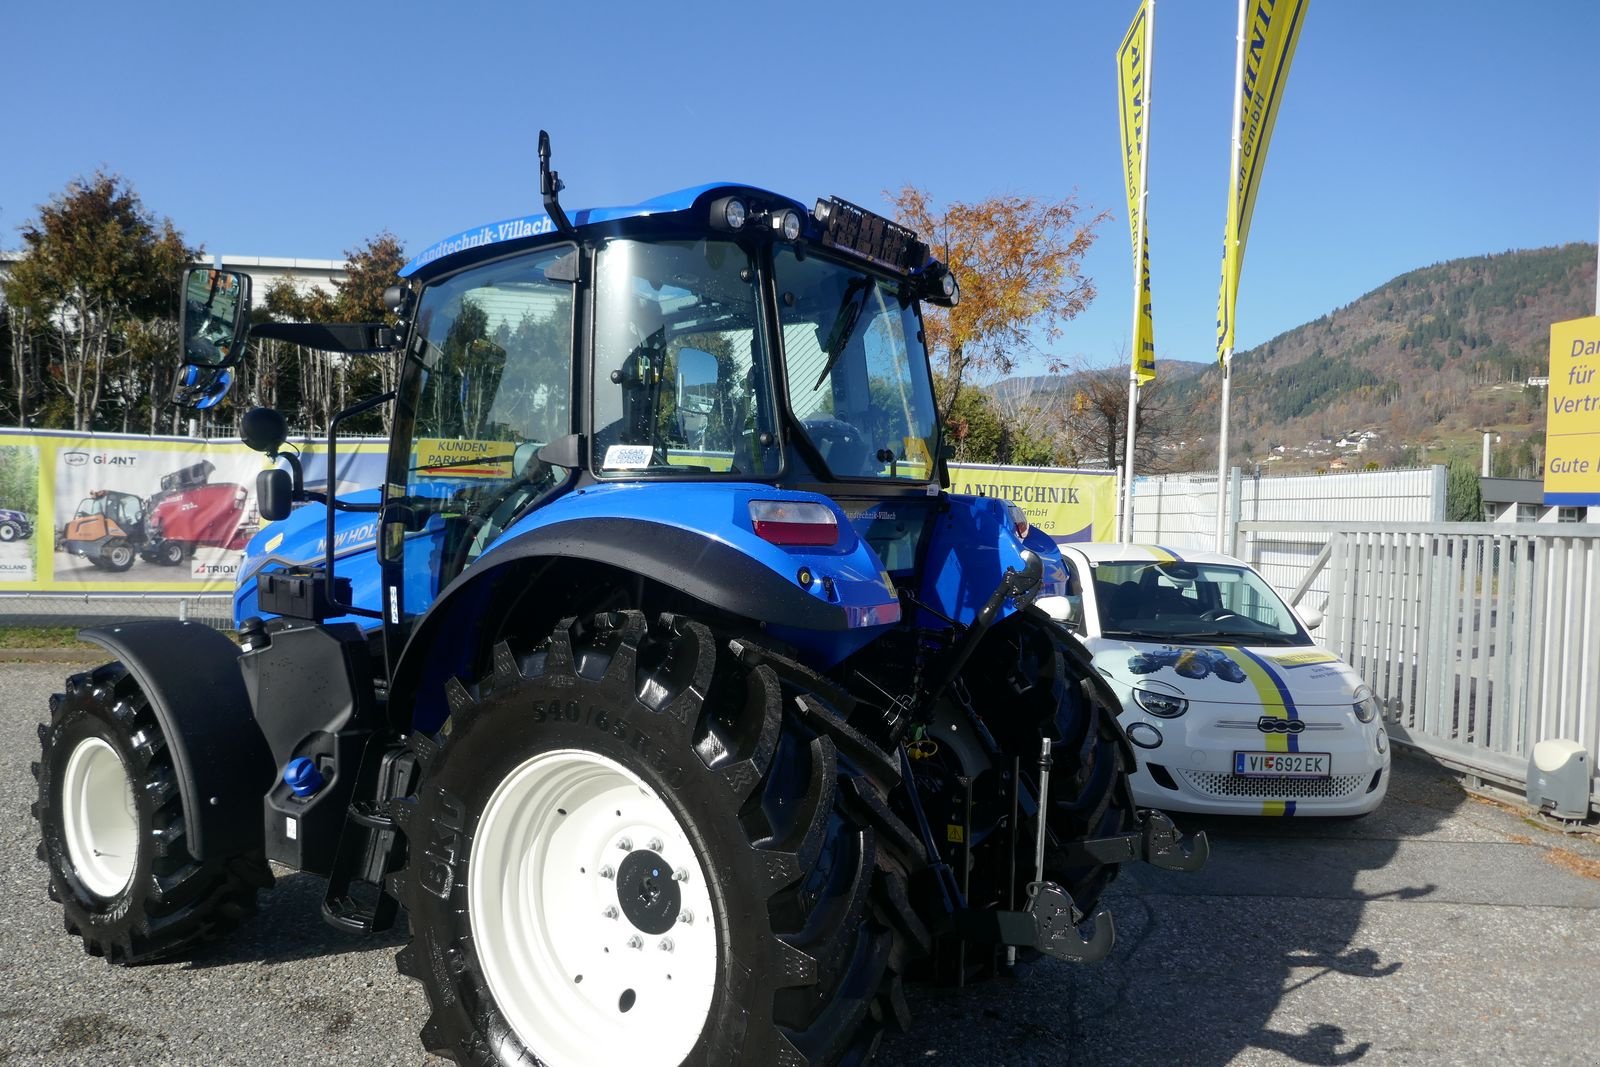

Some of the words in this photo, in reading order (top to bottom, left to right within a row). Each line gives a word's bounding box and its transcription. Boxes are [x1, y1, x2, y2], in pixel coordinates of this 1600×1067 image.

[415, 216, 552, 266] Landtechnik-Villach
[1568, 365, 1596, 385] für
[1553, 394, 1600, 414] Vertr
[438, 442, 494, 452] KUNDEN-
[1550, 457, 1589, 473] Gute
[1044, 520, 1055, 529] 63
[317, 533, 348, 553] NW
[347, 523, 378, 544] HOL
[1258, 716, 1305, 733] 500
